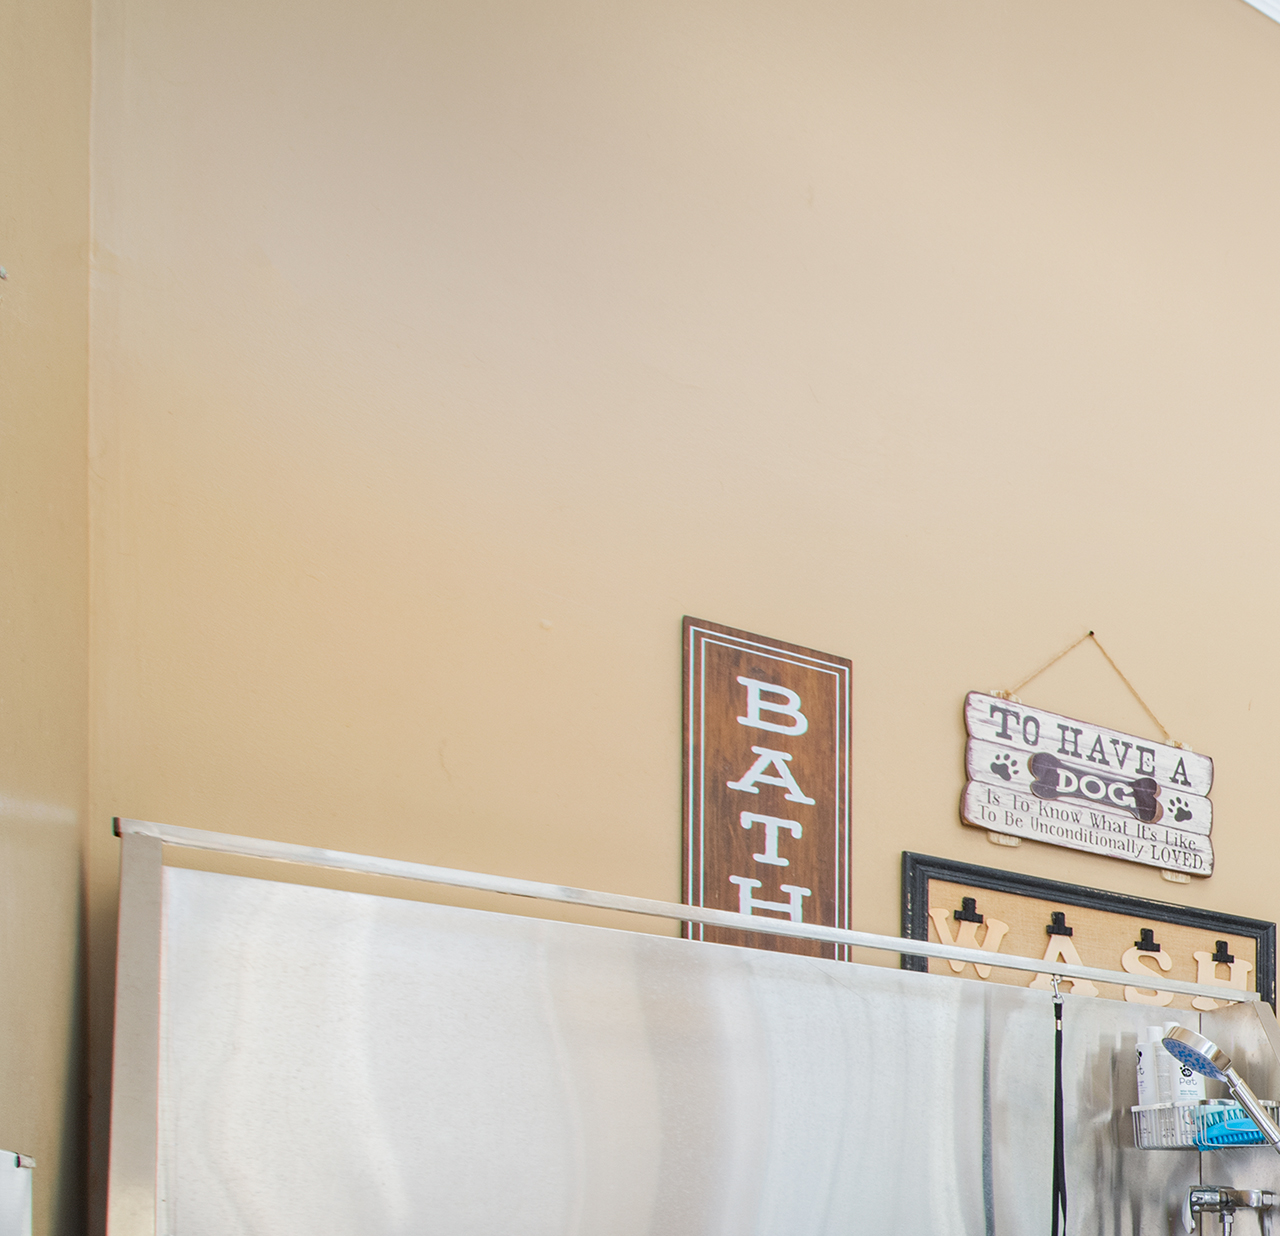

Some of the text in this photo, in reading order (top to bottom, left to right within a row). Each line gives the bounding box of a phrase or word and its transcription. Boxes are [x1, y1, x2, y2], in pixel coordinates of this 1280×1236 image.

[990, 705, 1192, 787] TO HAVE A
[727, 675, 815, 923] BATH
[987, 789, 1197, 850] Is To Know What It's Like
[1056, 769, 1136, 808] DOG
[978, 804, 1206, 871] To Be Unconditionally LOVED.
[928, 908, 1253, 1011] WASH
[1179, 1077, 1197, 1086] Pet
